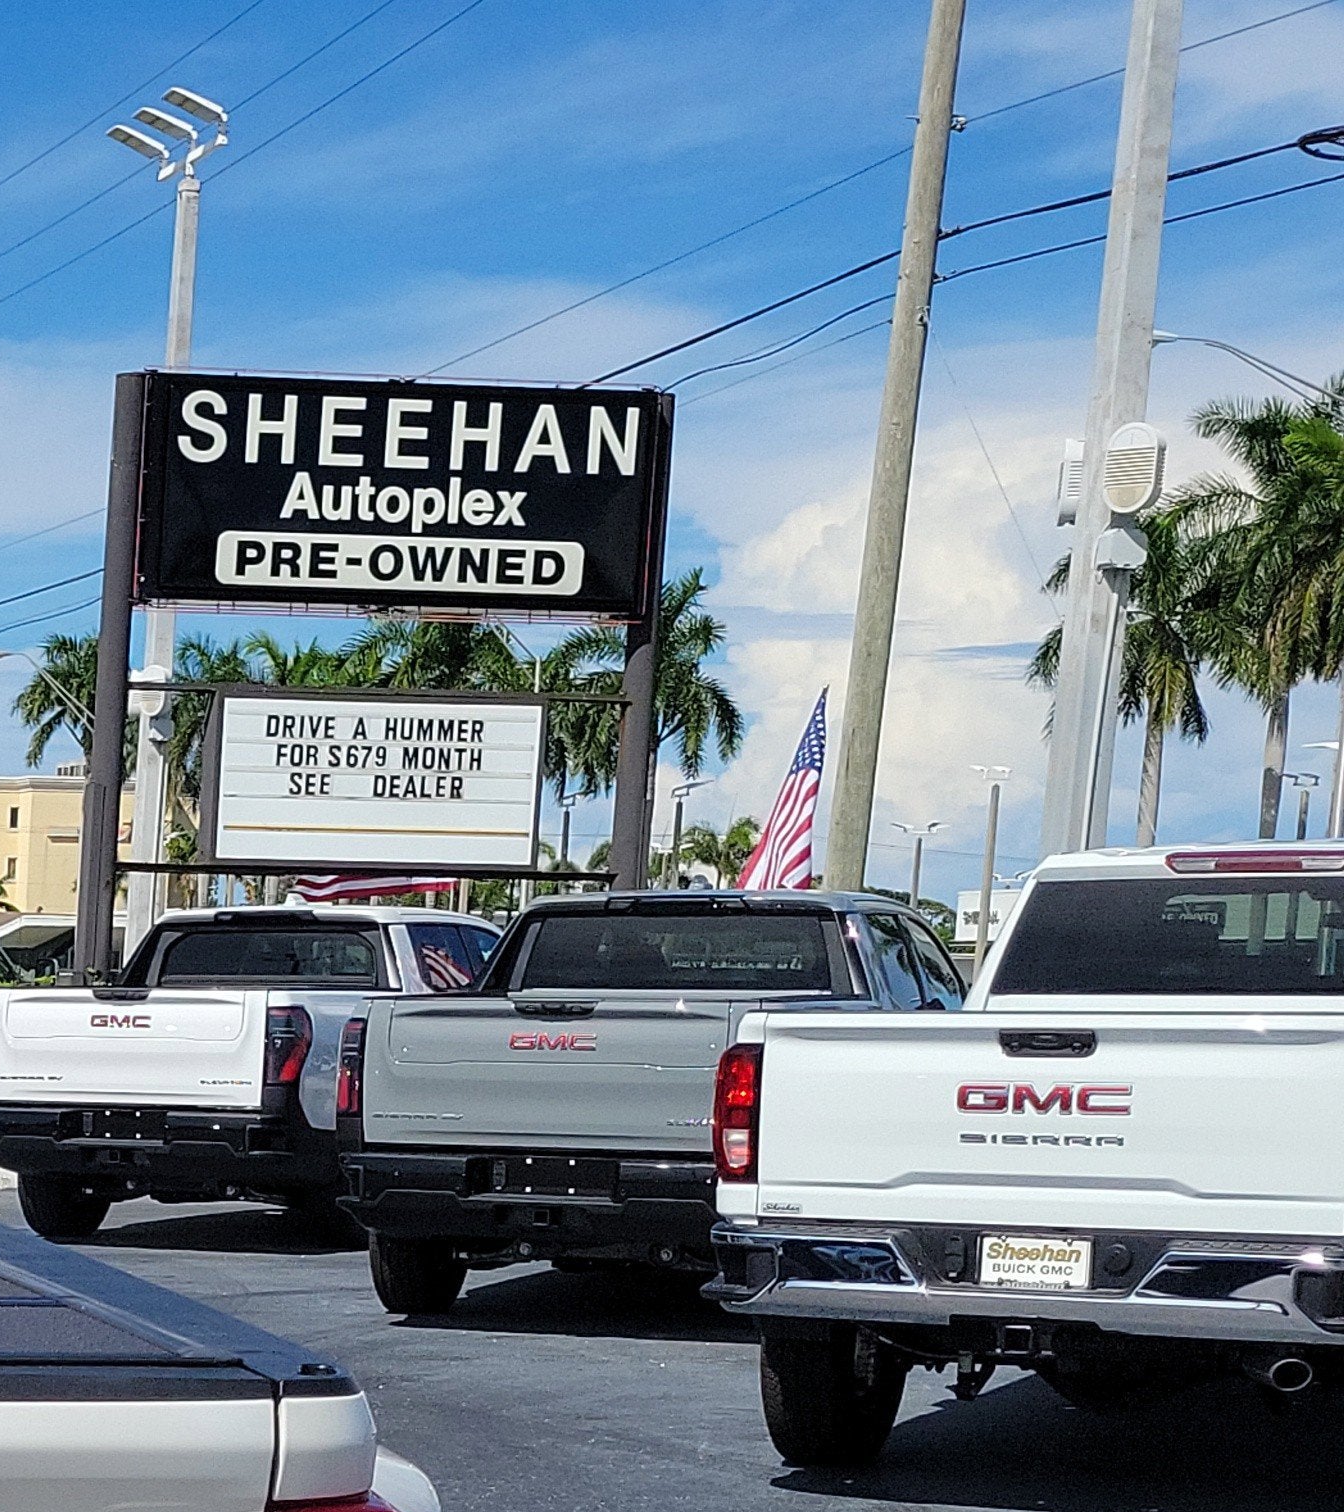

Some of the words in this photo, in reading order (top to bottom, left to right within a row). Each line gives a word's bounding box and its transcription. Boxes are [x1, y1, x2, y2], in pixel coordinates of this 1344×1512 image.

[177, 389, 641, 476] SHEEHAN
[279, 471, 527, 533] Autoplex
[234, 540, 566, 586] PRE-OWNED
[265, 715, 335, 739] DRIVE
[352, 717, 368, 739] A
[384, 717, 484, 743] HUMMER
[275, 744, 319, 767] FOR
[402, 747, 483, 771] MONTH
[288, 772, 331, 795] SEE
[373, 774, 463, 799] DEALER
[90, 1014, 152, 1029] GMC
[509, 1033, 597, 1051] GMC
[956, 1081, 1133, 1116] GMC
[959, 1133, 1125, 1147] SIERRA
[986, 1242, 1082, 1264] Sheehan
[992, 1263, 1036, 1275] BUICK
[1040, 1265, 1074, 1277] GMC
